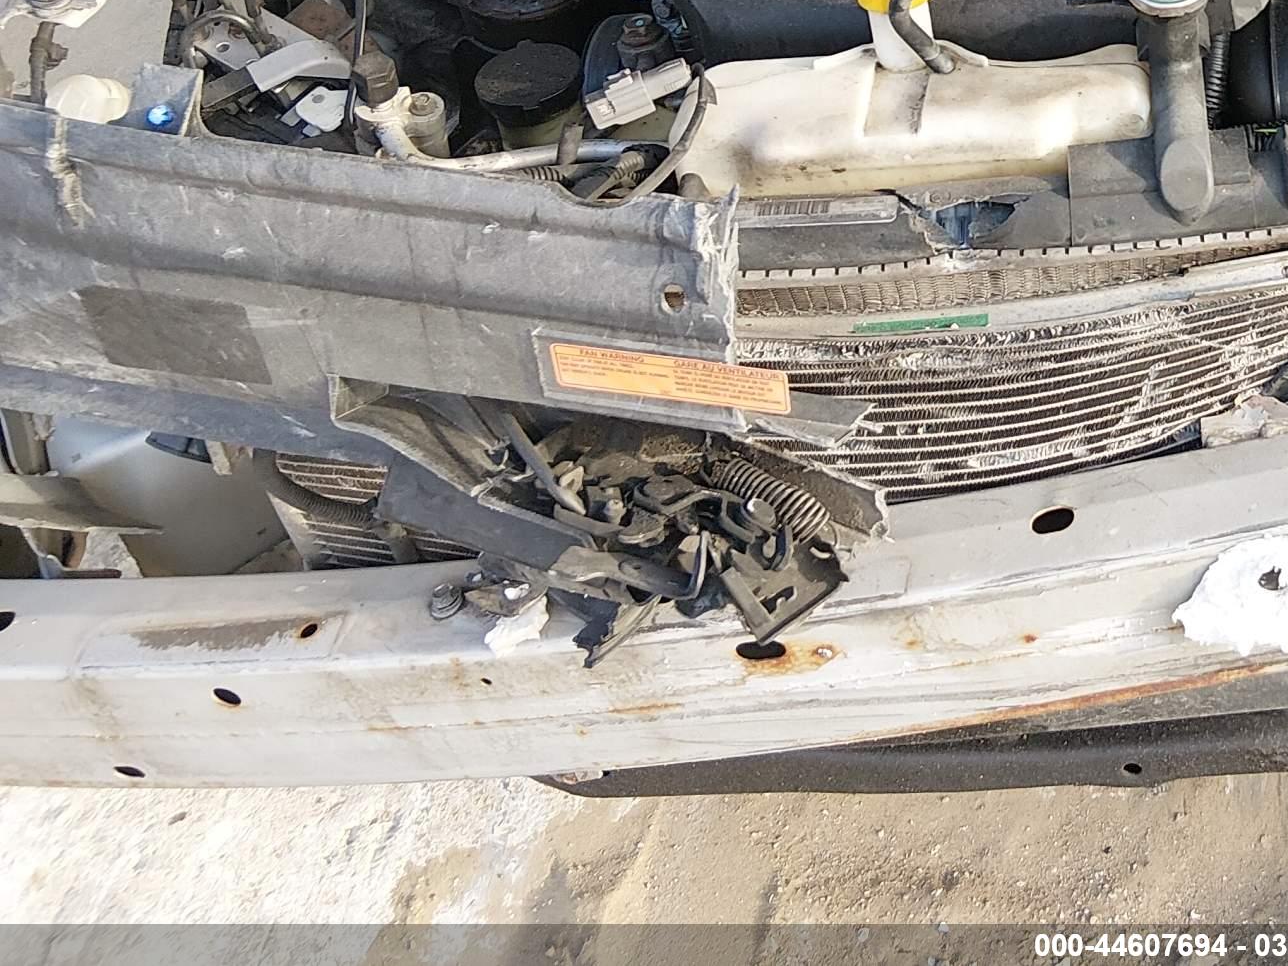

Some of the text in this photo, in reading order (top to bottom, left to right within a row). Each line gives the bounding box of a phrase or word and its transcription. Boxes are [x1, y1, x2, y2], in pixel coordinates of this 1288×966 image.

[579, 348, 600, 357] FAN
[600, 351, 645, 363] WARNING
[716, 365, 780, 380] VENTILATEUR
